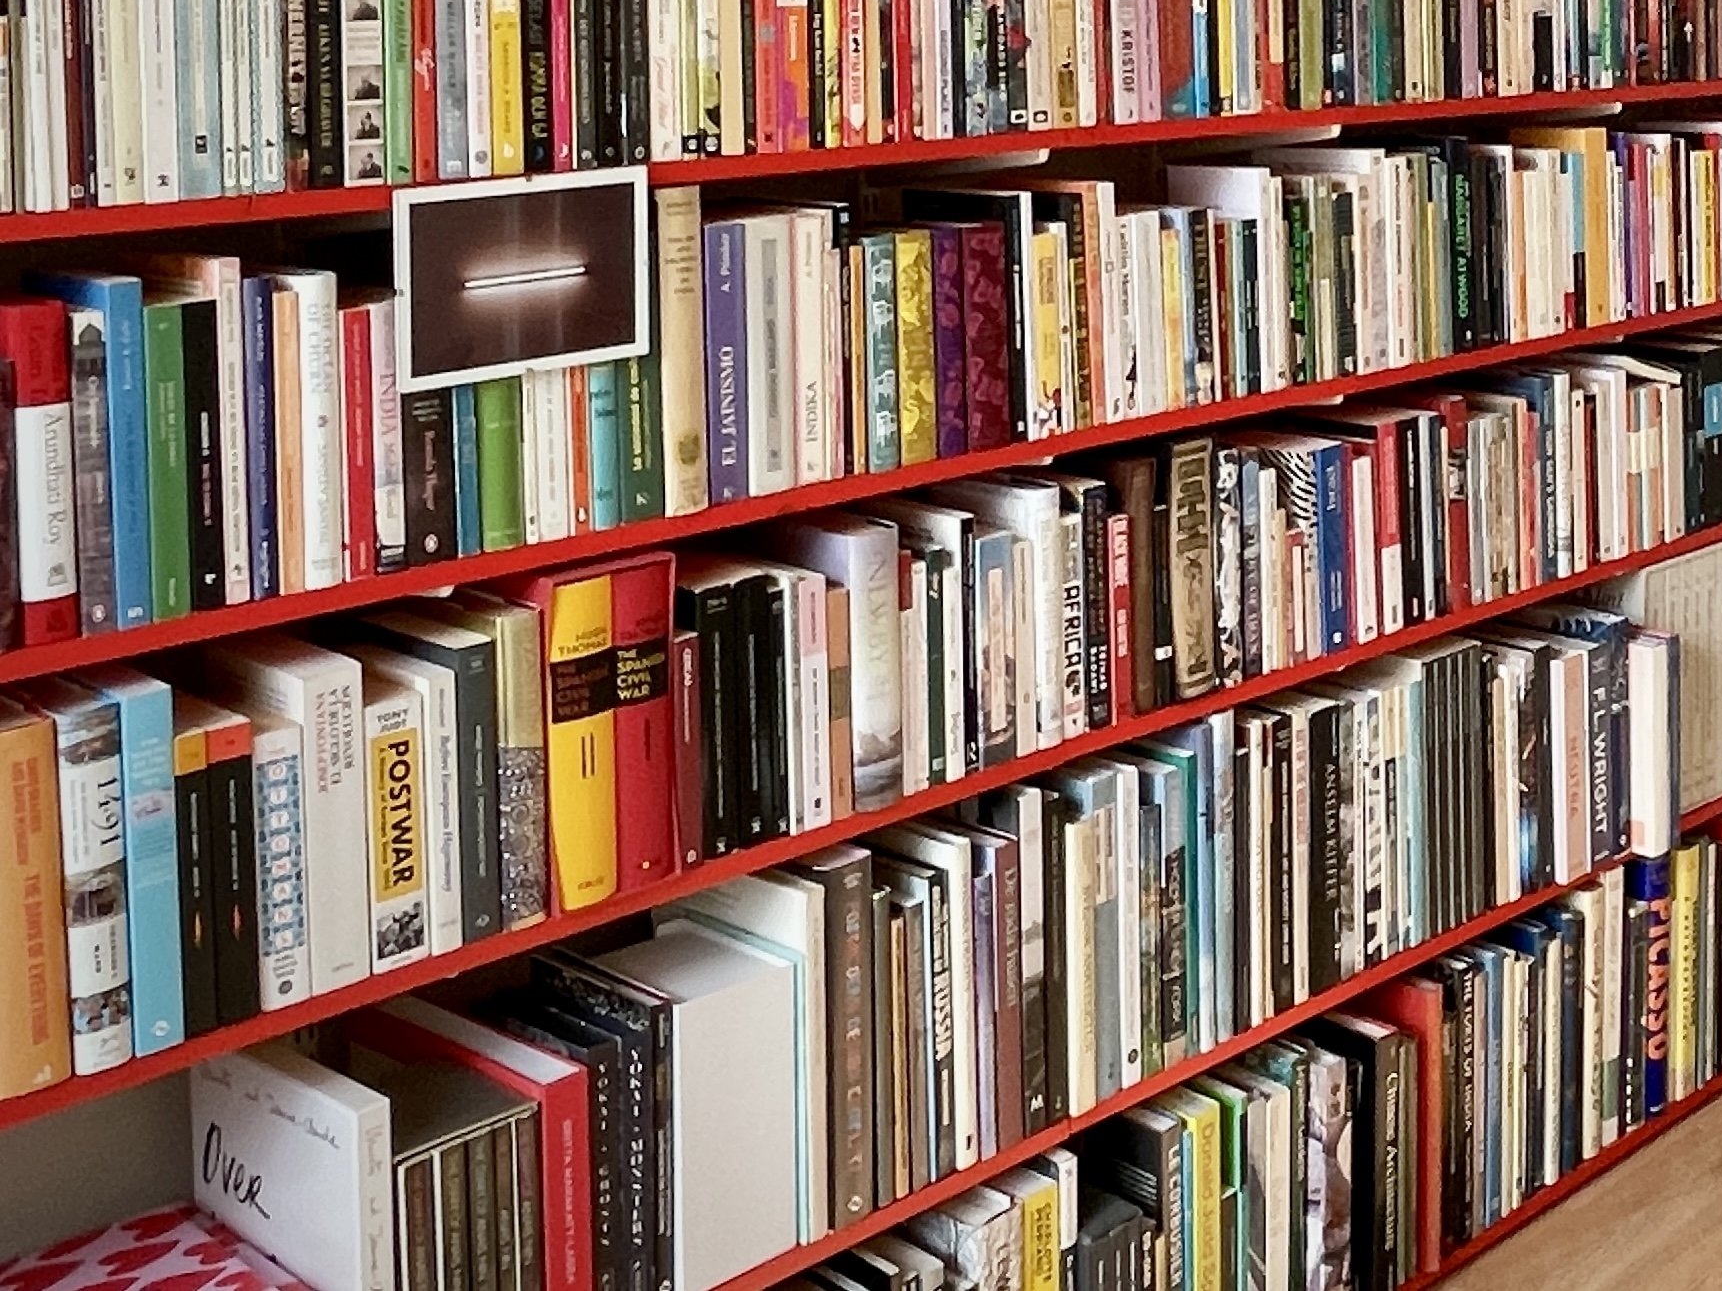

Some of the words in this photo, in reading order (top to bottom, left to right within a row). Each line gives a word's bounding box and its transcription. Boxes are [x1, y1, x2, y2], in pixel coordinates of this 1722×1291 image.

[1120, 29, 1136, 96] KRISTOF
[1454, 173, 1469, 252] MARGARET
[1456, 256, 1469, 319] ATWOOD
[379, 372, 397, 437] INDIA
[717, 345, 737, 435] JAINISMO
[803, 380, 819, 443] INDIKA
[43, 412, 68, 506] Arundhati
[720, 440, 737, 467] EL
[44, 510, 67, 546] Roy
[1062, 584, 1083, 669] AFRICA
[616, 669, 653, 689] CIVIL
[616, 684, 651, 701] WAR
[92, 777, 121, 847] 1491
[387, 739, 416, 888] POSTWAR
[1647, 898, 1672, 1061] PICASSO
[933, 969, 954, 1063] RUSSIA
[1168, 1143, 1182, 1172] LE
[1202, 1122, 1217, 1202] Donald
[1169, 1175, 1184, 1288] CORBUSIER
